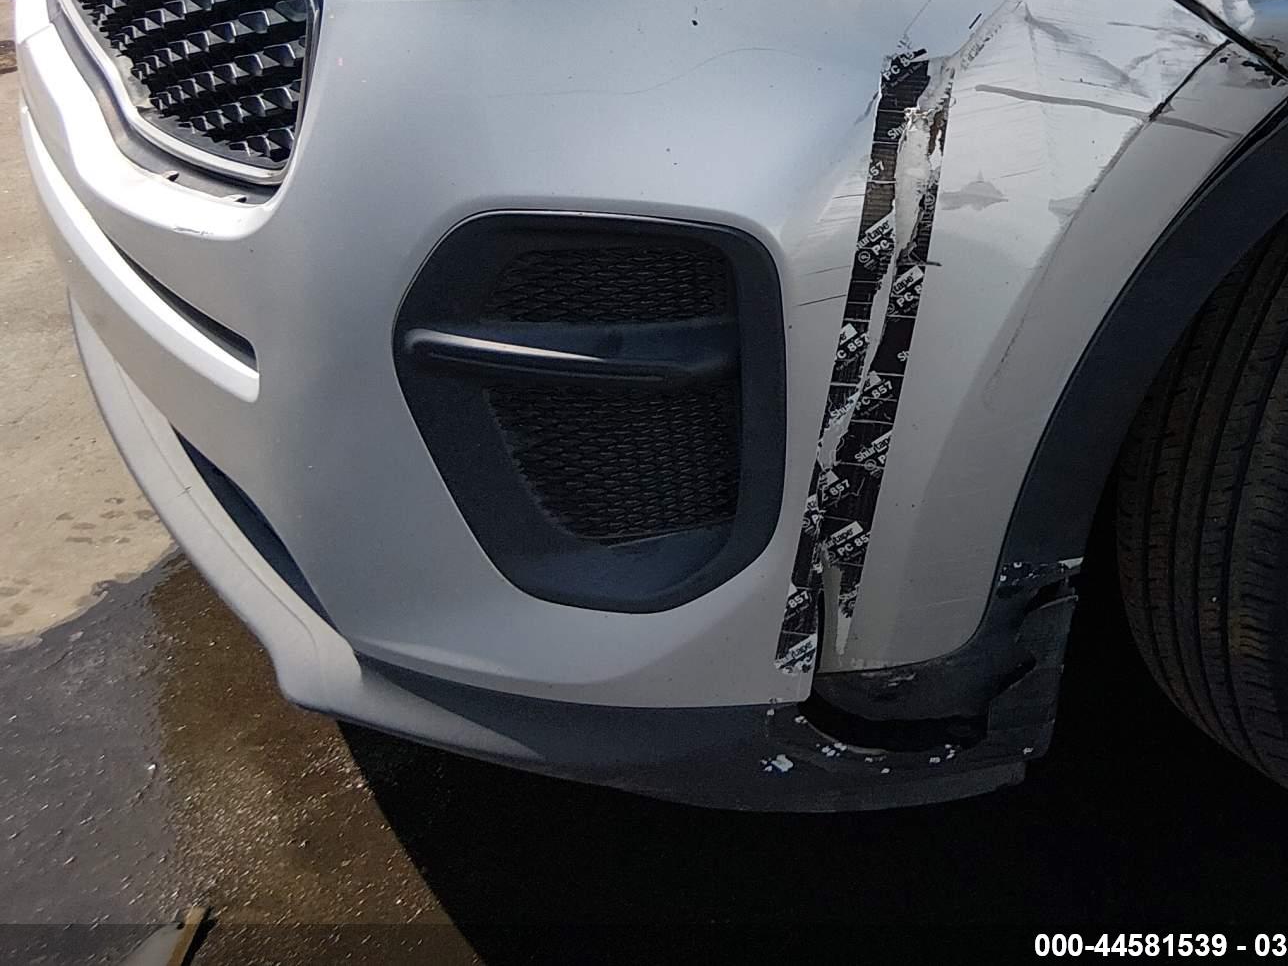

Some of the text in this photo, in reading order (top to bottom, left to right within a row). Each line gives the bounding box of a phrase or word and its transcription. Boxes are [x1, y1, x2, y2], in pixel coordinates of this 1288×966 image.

[872, 239, 890, 256] PC
[896, 292, 914, 307] PC
[847, 332, 870, 353] 857
[872, 380, 893, 399] 857
[830, 478, 850, 496] 857
[837, 543, 854, 556] PC
[788, 590, 809, 609] 857
